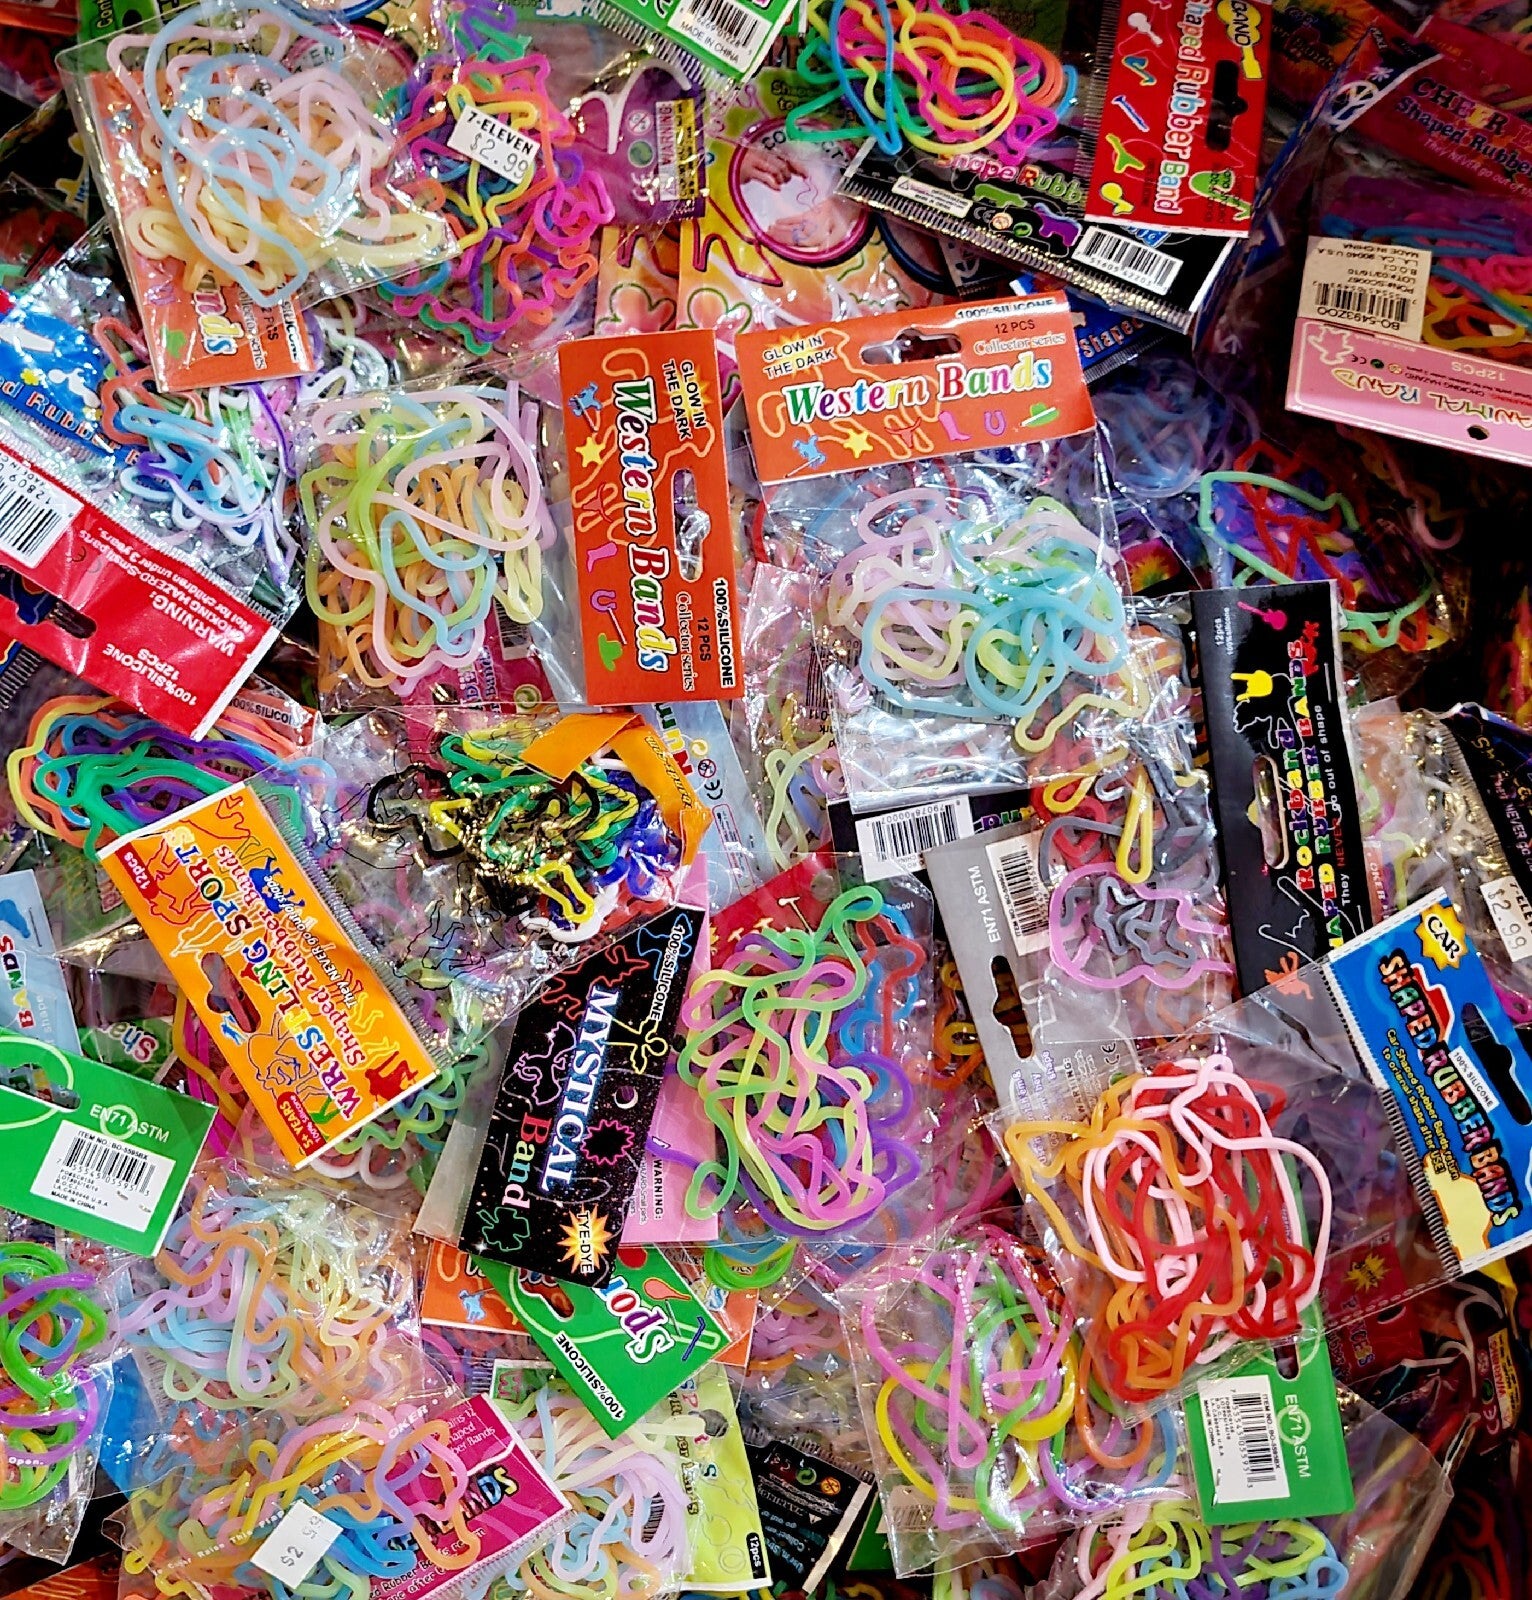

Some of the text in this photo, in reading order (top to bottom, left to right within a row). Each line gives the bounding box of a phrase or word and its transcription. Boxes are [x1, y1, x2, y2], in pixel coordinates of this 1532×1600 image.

[681, 23, 740, 63] MADE IN CHINA
[466, 110, 533, 155] 7-ELEVEN
[1154, 64, 1209, 214] Rubber Band
[1398, 95, 1468, 144] Shaped
[470, 132, 529, 179] $2.99
[763, 334, 824, 363] GLOW IN
[994, 318, 1036, 335] 12 PCS
[764, 348, 835, 379] THE DARK
[1451, 361, 1506, 382] 12PCS
[663, 358, 693, 441] THE DARK
[681, 360, 706, 428] GLOW IN
[784, 352, 1052, 425] Western Bands
[614, 376, 678, 673] Western Bands
[98, 528, 253, 634] Not for children under 3 years.
[148, 592, 237, 658] WARNING:
[676, 591, 698, 692] Collector series
[698, 617, 711, 662] 12 PCS
[713, 578, 736, 689] 100%SILICONE
[1214, 617, 1225, 646] 12pcs
[102, 643, 197, 707] 100%SILICONE
[137, 647, 180, 681] 12PCS
[1286, 639, 1331, 855] RUBBER BANDS
[1314, 704, 1329, 744] shape
[1323, 749, 1332, 764] of
[1324, 767, 1337, 790] out
[1333, 817, 1346, 868] NEVER
[123, 851, 152, 891] 12pcs
[263, 875, 288, 904] shape
[1340, 873, 1351, 906] They
[288, 914, 306, 932] out
[966, 864, 1002, 944] EN71 ASTM
[1487, 888, 1527, 950] $2.99
[213, 845, 366, 1067] Shaped Rubber Bands
[302, 932, 319, 946] go
[1426, 914, 1461, 960] CAR
[164, 826, 361, 1120] WRESTLING SPORTS
[311, 945, 341, 982] NEVER
[650, 923, 687, 1023] 100%SILICONE
[337, 981, 359, 1009] They
[1041, 1050, 1057, 1079] shape
[1379, 948, 1523, 1229] SHAPED RUBBER BANDS
[1453, 1050, 1494, 1109] 100% SILICONE
[541, 985, 620, 1193] MYSTICAL
[1382, 1048, 1447, 1175] to shape after USE!
[1386, 1028, 1460, 1181] Car Shaped Rubber Bands return
[77, 1130, 95, 1142] ITEM
[89, 1103, 170, 1144] EN71 ASTM
[279, 1100, 314, 1150] 5+ YEARS
[305, 1122, 323, 1144] 100%
[503, 1111, 552, 1210] Band
[646, 1159, 668, 1219] WARNING:
[576, 1209, 595, 1274] TYE-DYE
[553, 1330, 626, 1421] 100%SILICONE
[467, 1426, 497, 1447] Bands
[1284, 1394, 1312, 1479] EN71 ASTM
[749, 1534, 764, 1570] 12pcs
[381, 1567, 418, 1593] Rubber
[408, 1571, 435, 1594] after
